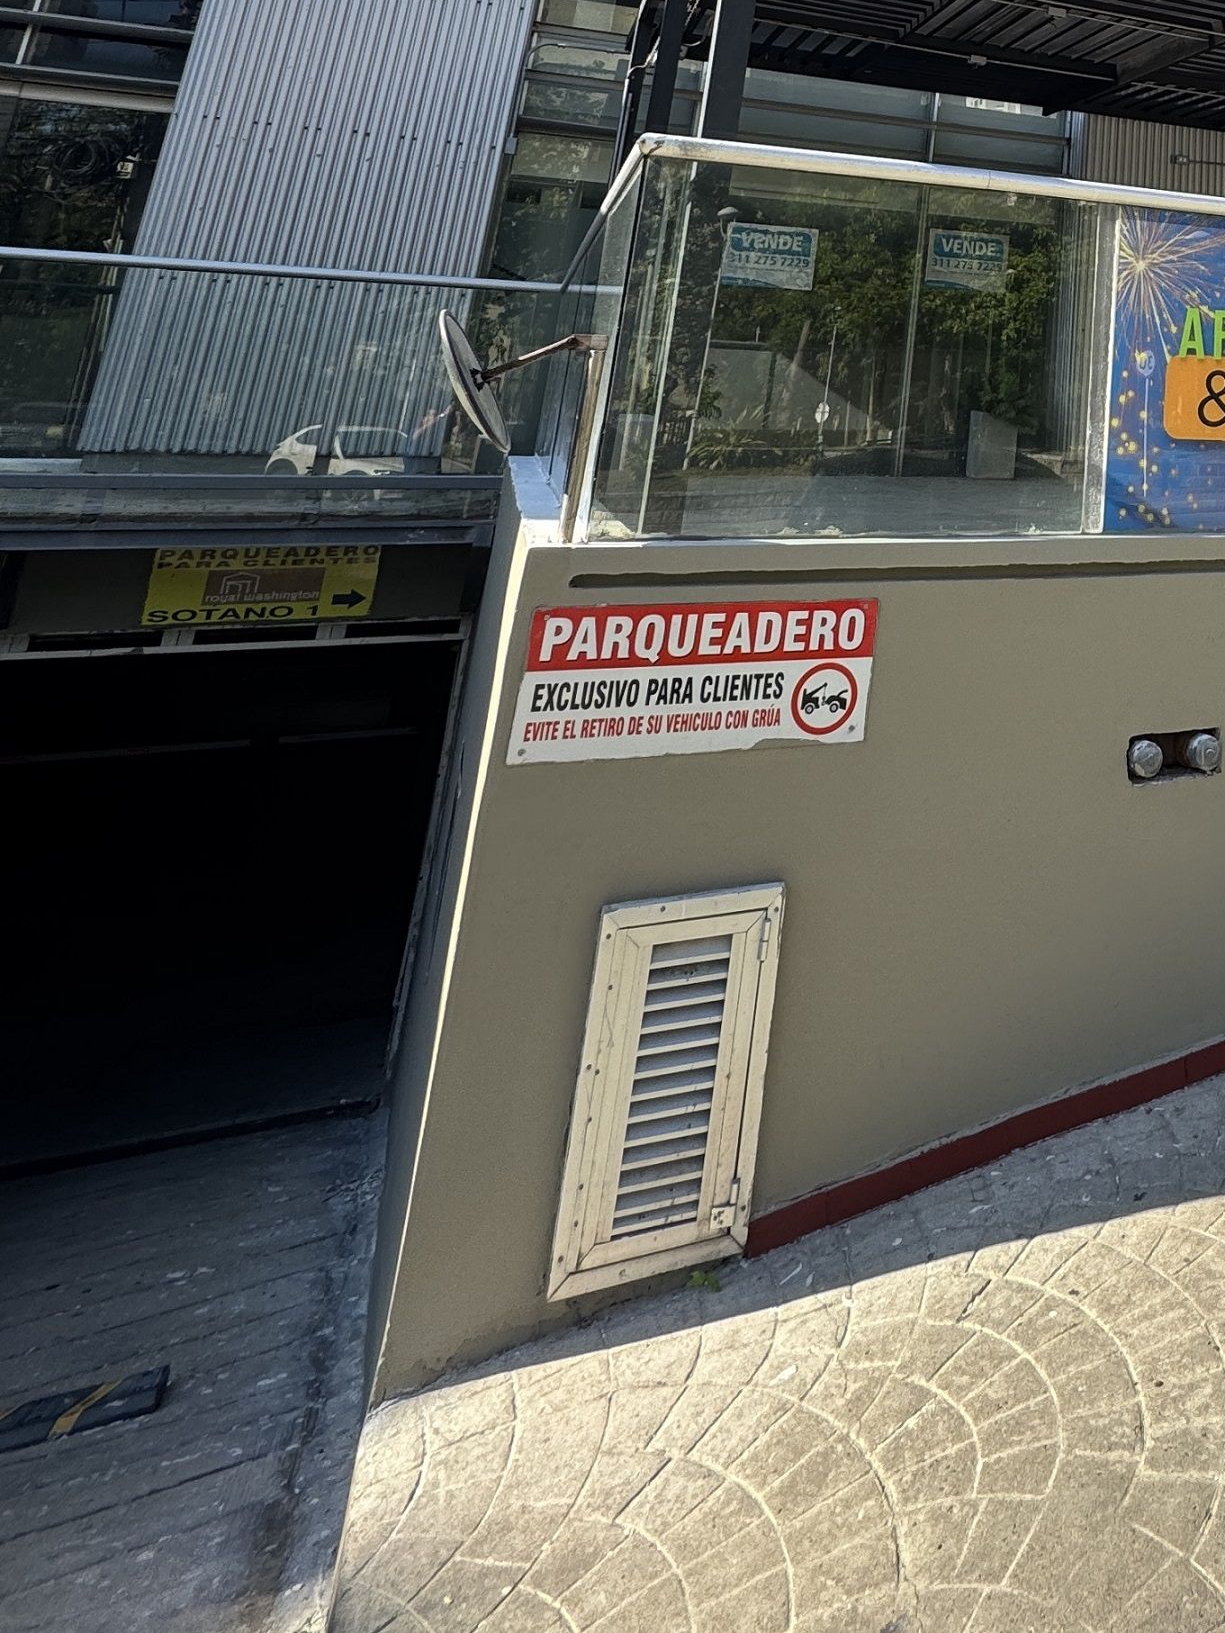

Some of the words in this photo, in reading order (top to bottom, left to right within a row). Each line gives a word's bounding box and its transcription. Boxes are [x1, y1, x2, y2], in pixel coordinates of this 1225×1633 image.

[740, 230, 804, 251] VENDE
[939, 236, 997, 257] VENDE
[753, 253, 778, 267] 275
[780, 255, 811, 269] 7229
[931, 256, 952, 269] 311
[156, 559, 232, 569] PARA
[243, 556, 378, 568] CLIENTES
[158, 545, 380, 562] PARQUEADERO
[205, 592, 241, 606] royal
[243, 588, 320, 604] washington
[147, 605, 292, 623] SOTANO
[306, 604, 319, 617] 1
[538, 608, 867, 665] PARQUEADERO
[530, 678, 640, 713] EXCLUSIVO
[645, 676, 693, 707] PARA
[699, 671, 785, 704] CLIENTES
[523, 720, 560, 743] EVITE
[562, 720, 577, 740] EL
[580, 717, 625, 739] RETIRO
[628, 716, 645, 737] DE
[647, 714, 663, 736] SU
[665, 711, 722, 735] VEHICULO
[724, 710, 750, 731] CON
[751, 704, 782, 729] GRÚA
